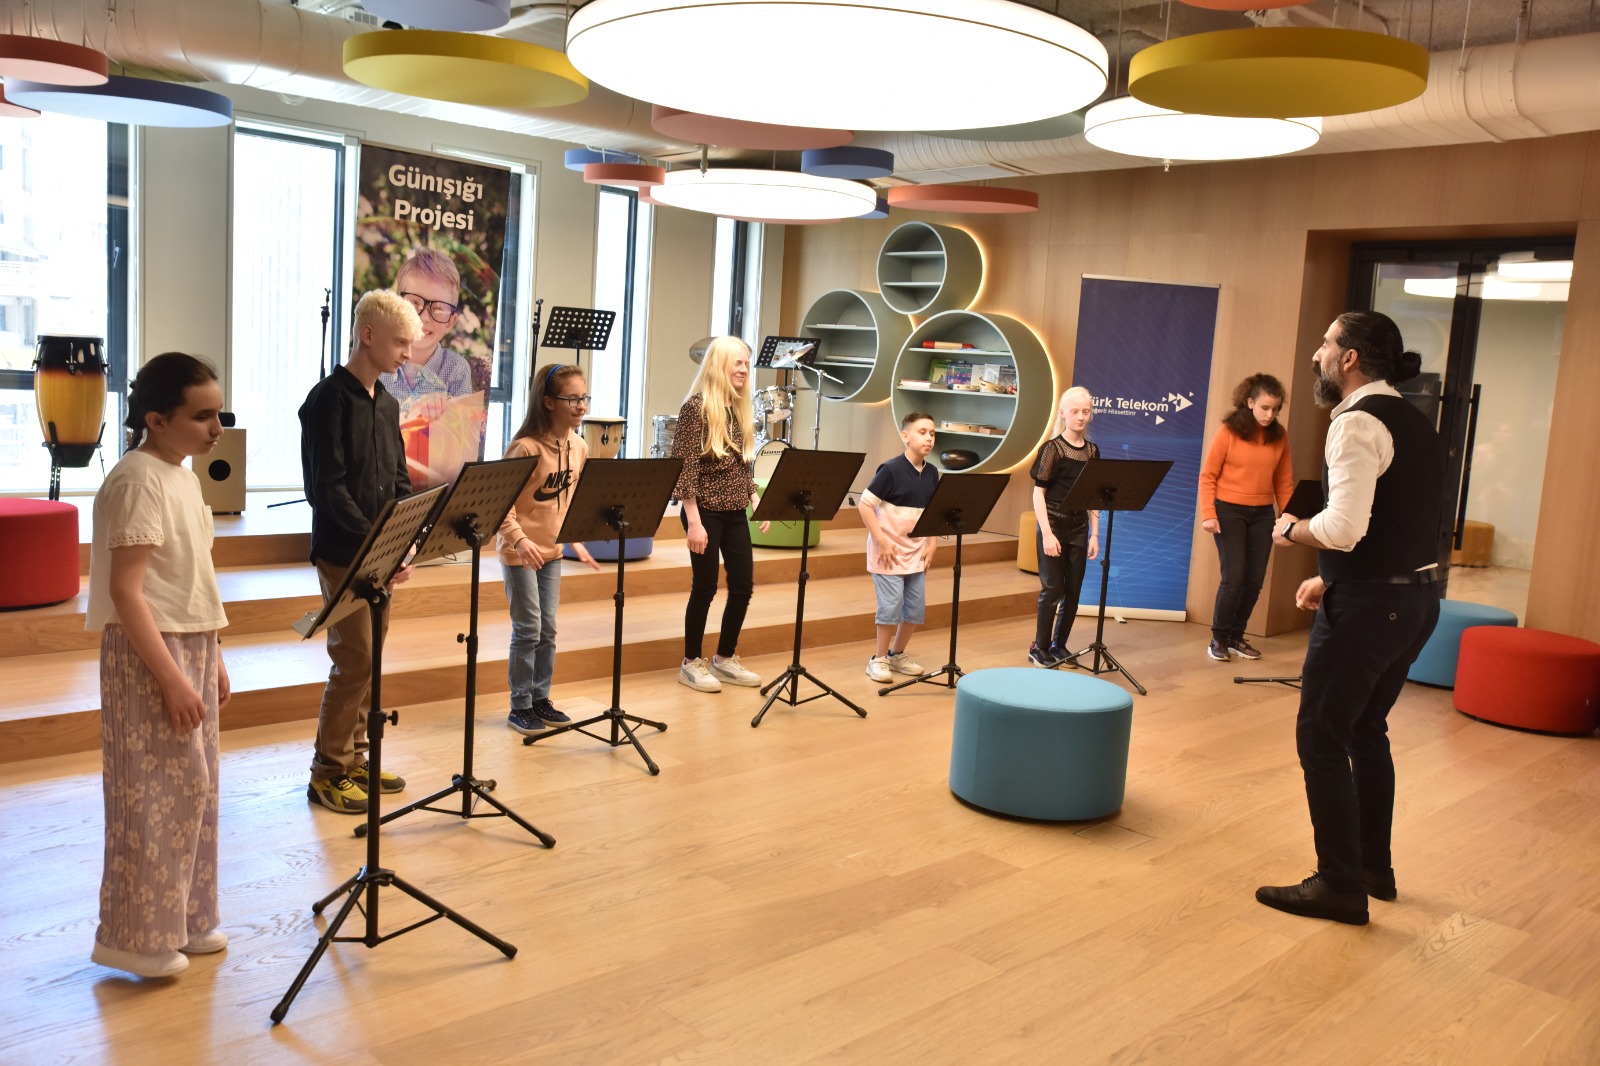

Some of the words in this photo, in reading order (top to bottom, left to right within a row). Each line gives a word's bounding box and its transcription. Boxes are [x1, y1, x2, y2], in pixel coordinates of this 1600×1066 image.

[388, 164, 484, 203] Günışığı
[394, 199, 475, 231] Projesi
[1090, 395, 1113, 408] ürk
[1116, 397, 1169, 412] Telekom
[542, 469, 573, 489] NIKE
